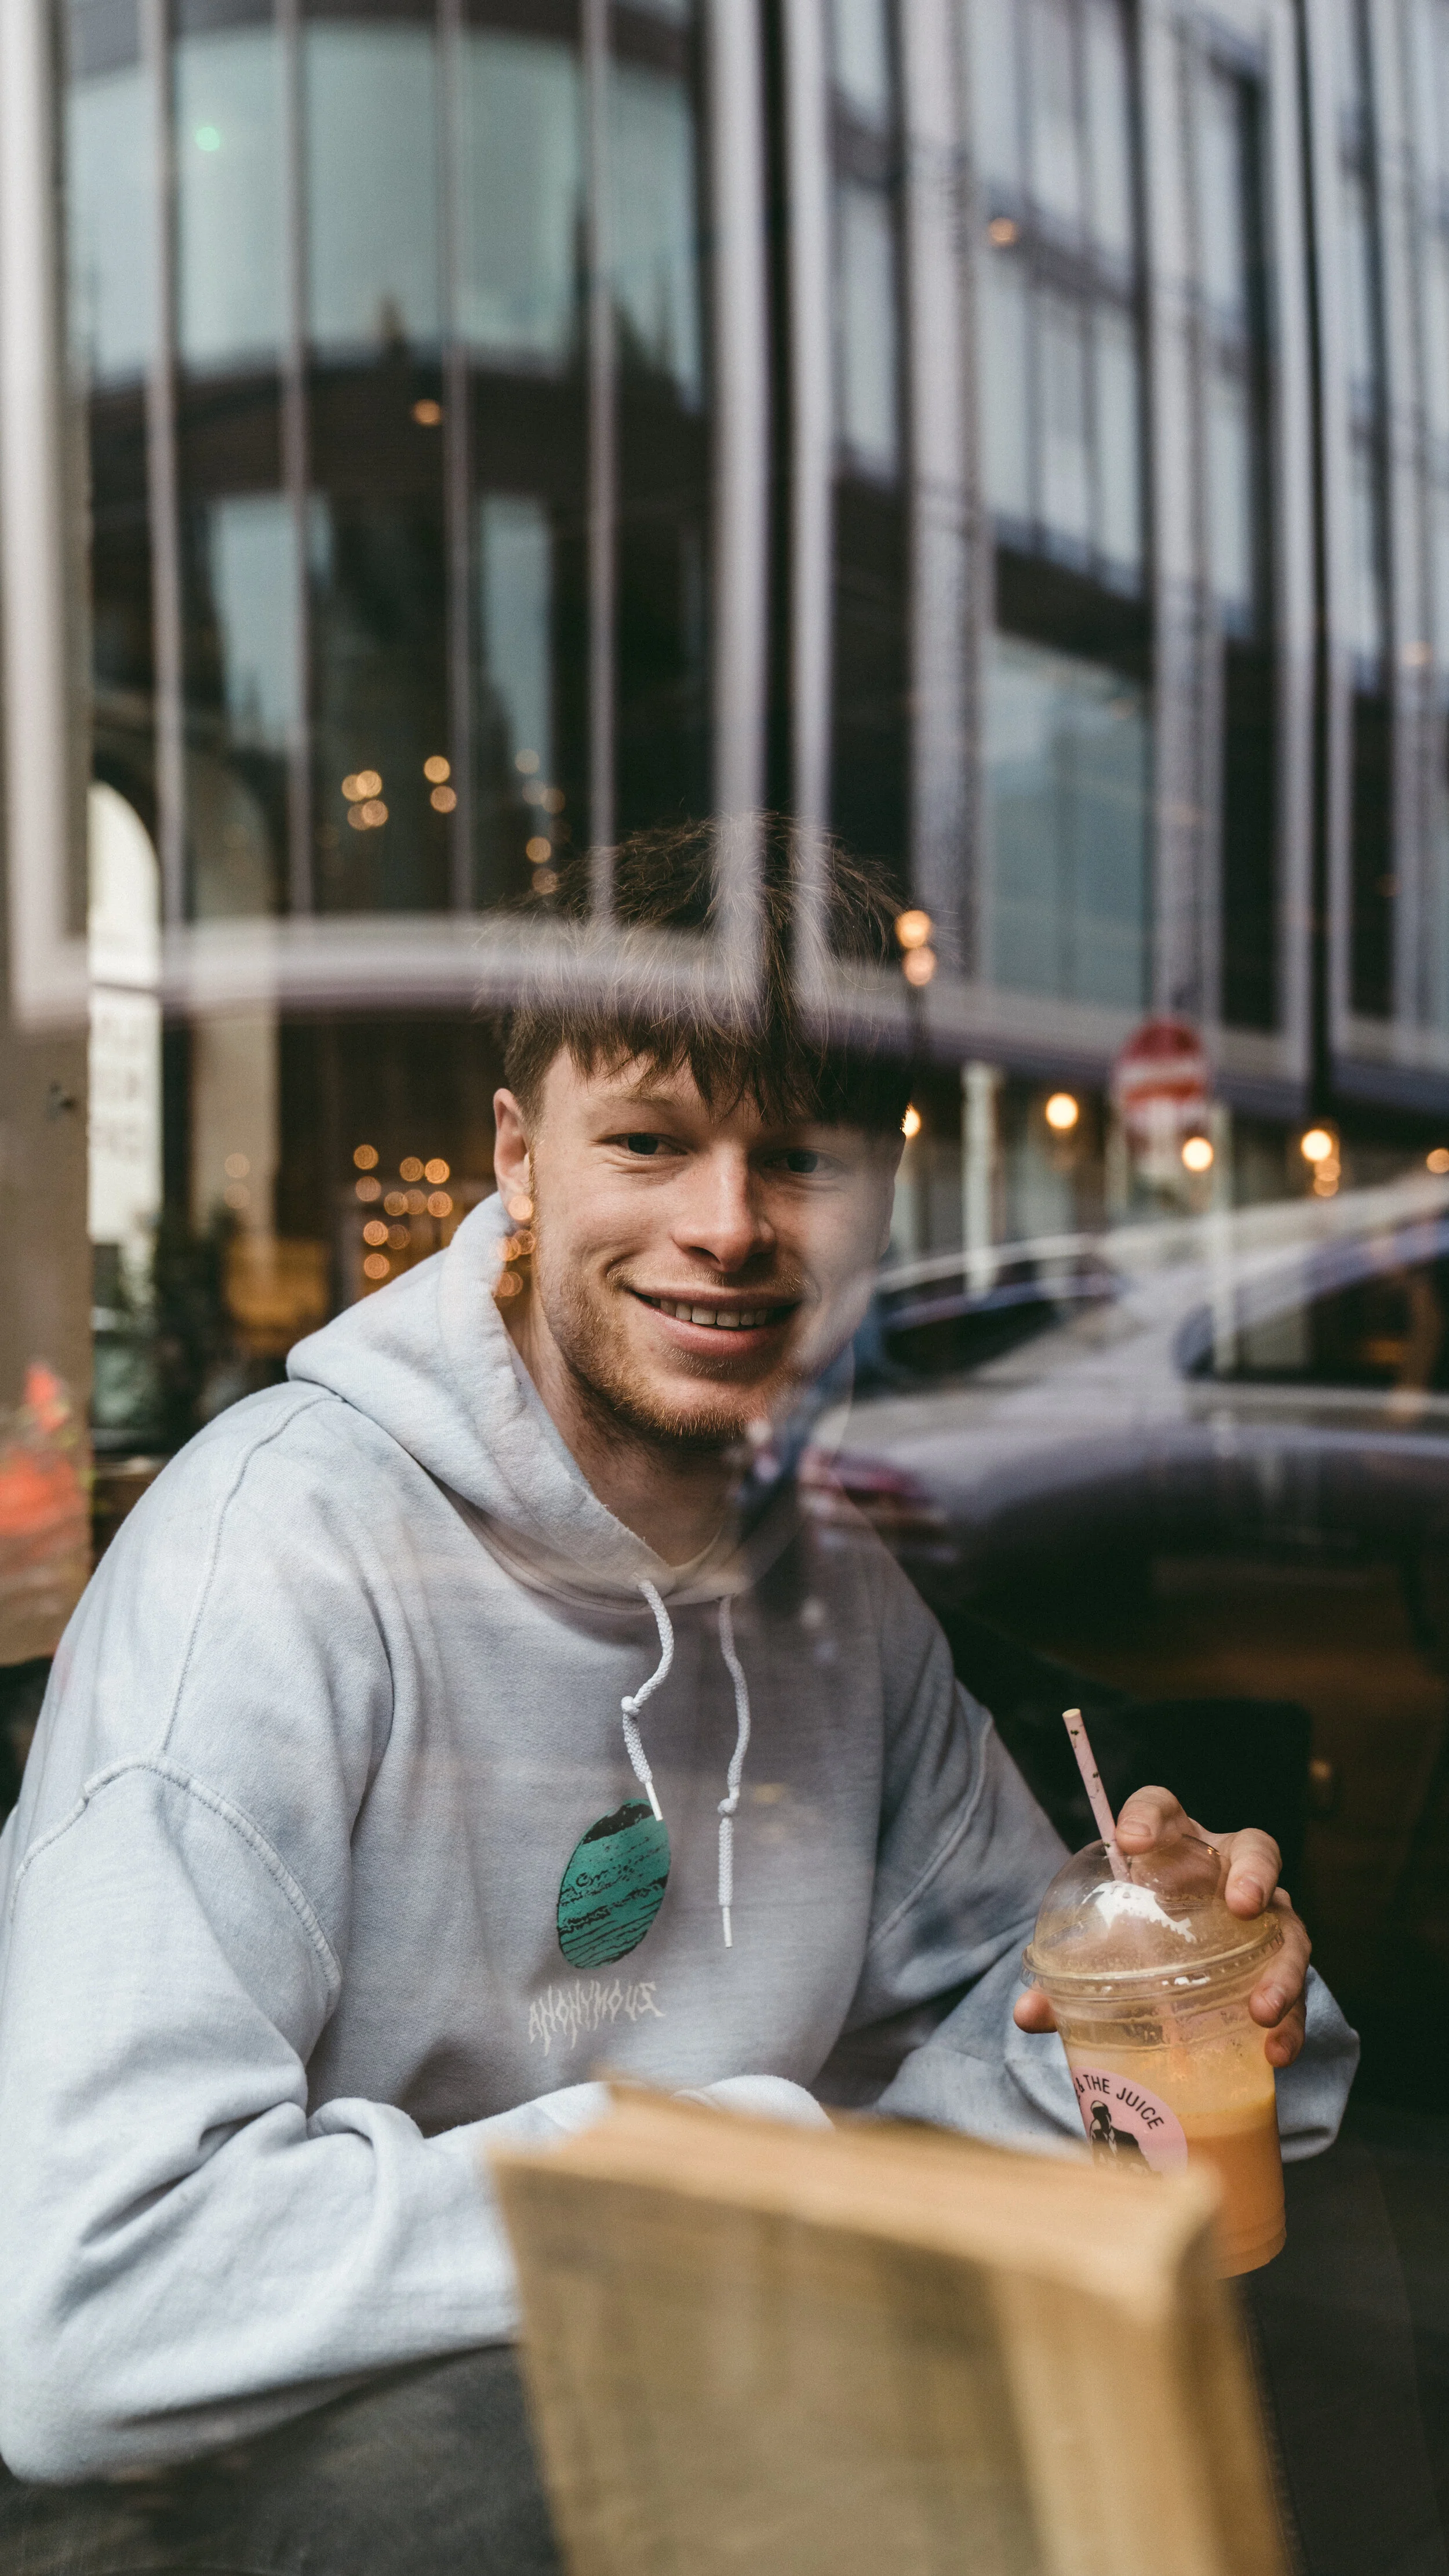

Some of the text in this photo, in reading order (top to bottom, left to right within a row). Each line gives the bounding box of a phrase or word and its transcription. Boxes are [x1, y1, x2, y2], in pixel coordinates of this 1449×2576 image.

[528, 1979, 665, 2057] ANONYMOUS
[1083, 2074, 1110, 2094] THE
[1116, 2088, 1164, 2130] JUICE
